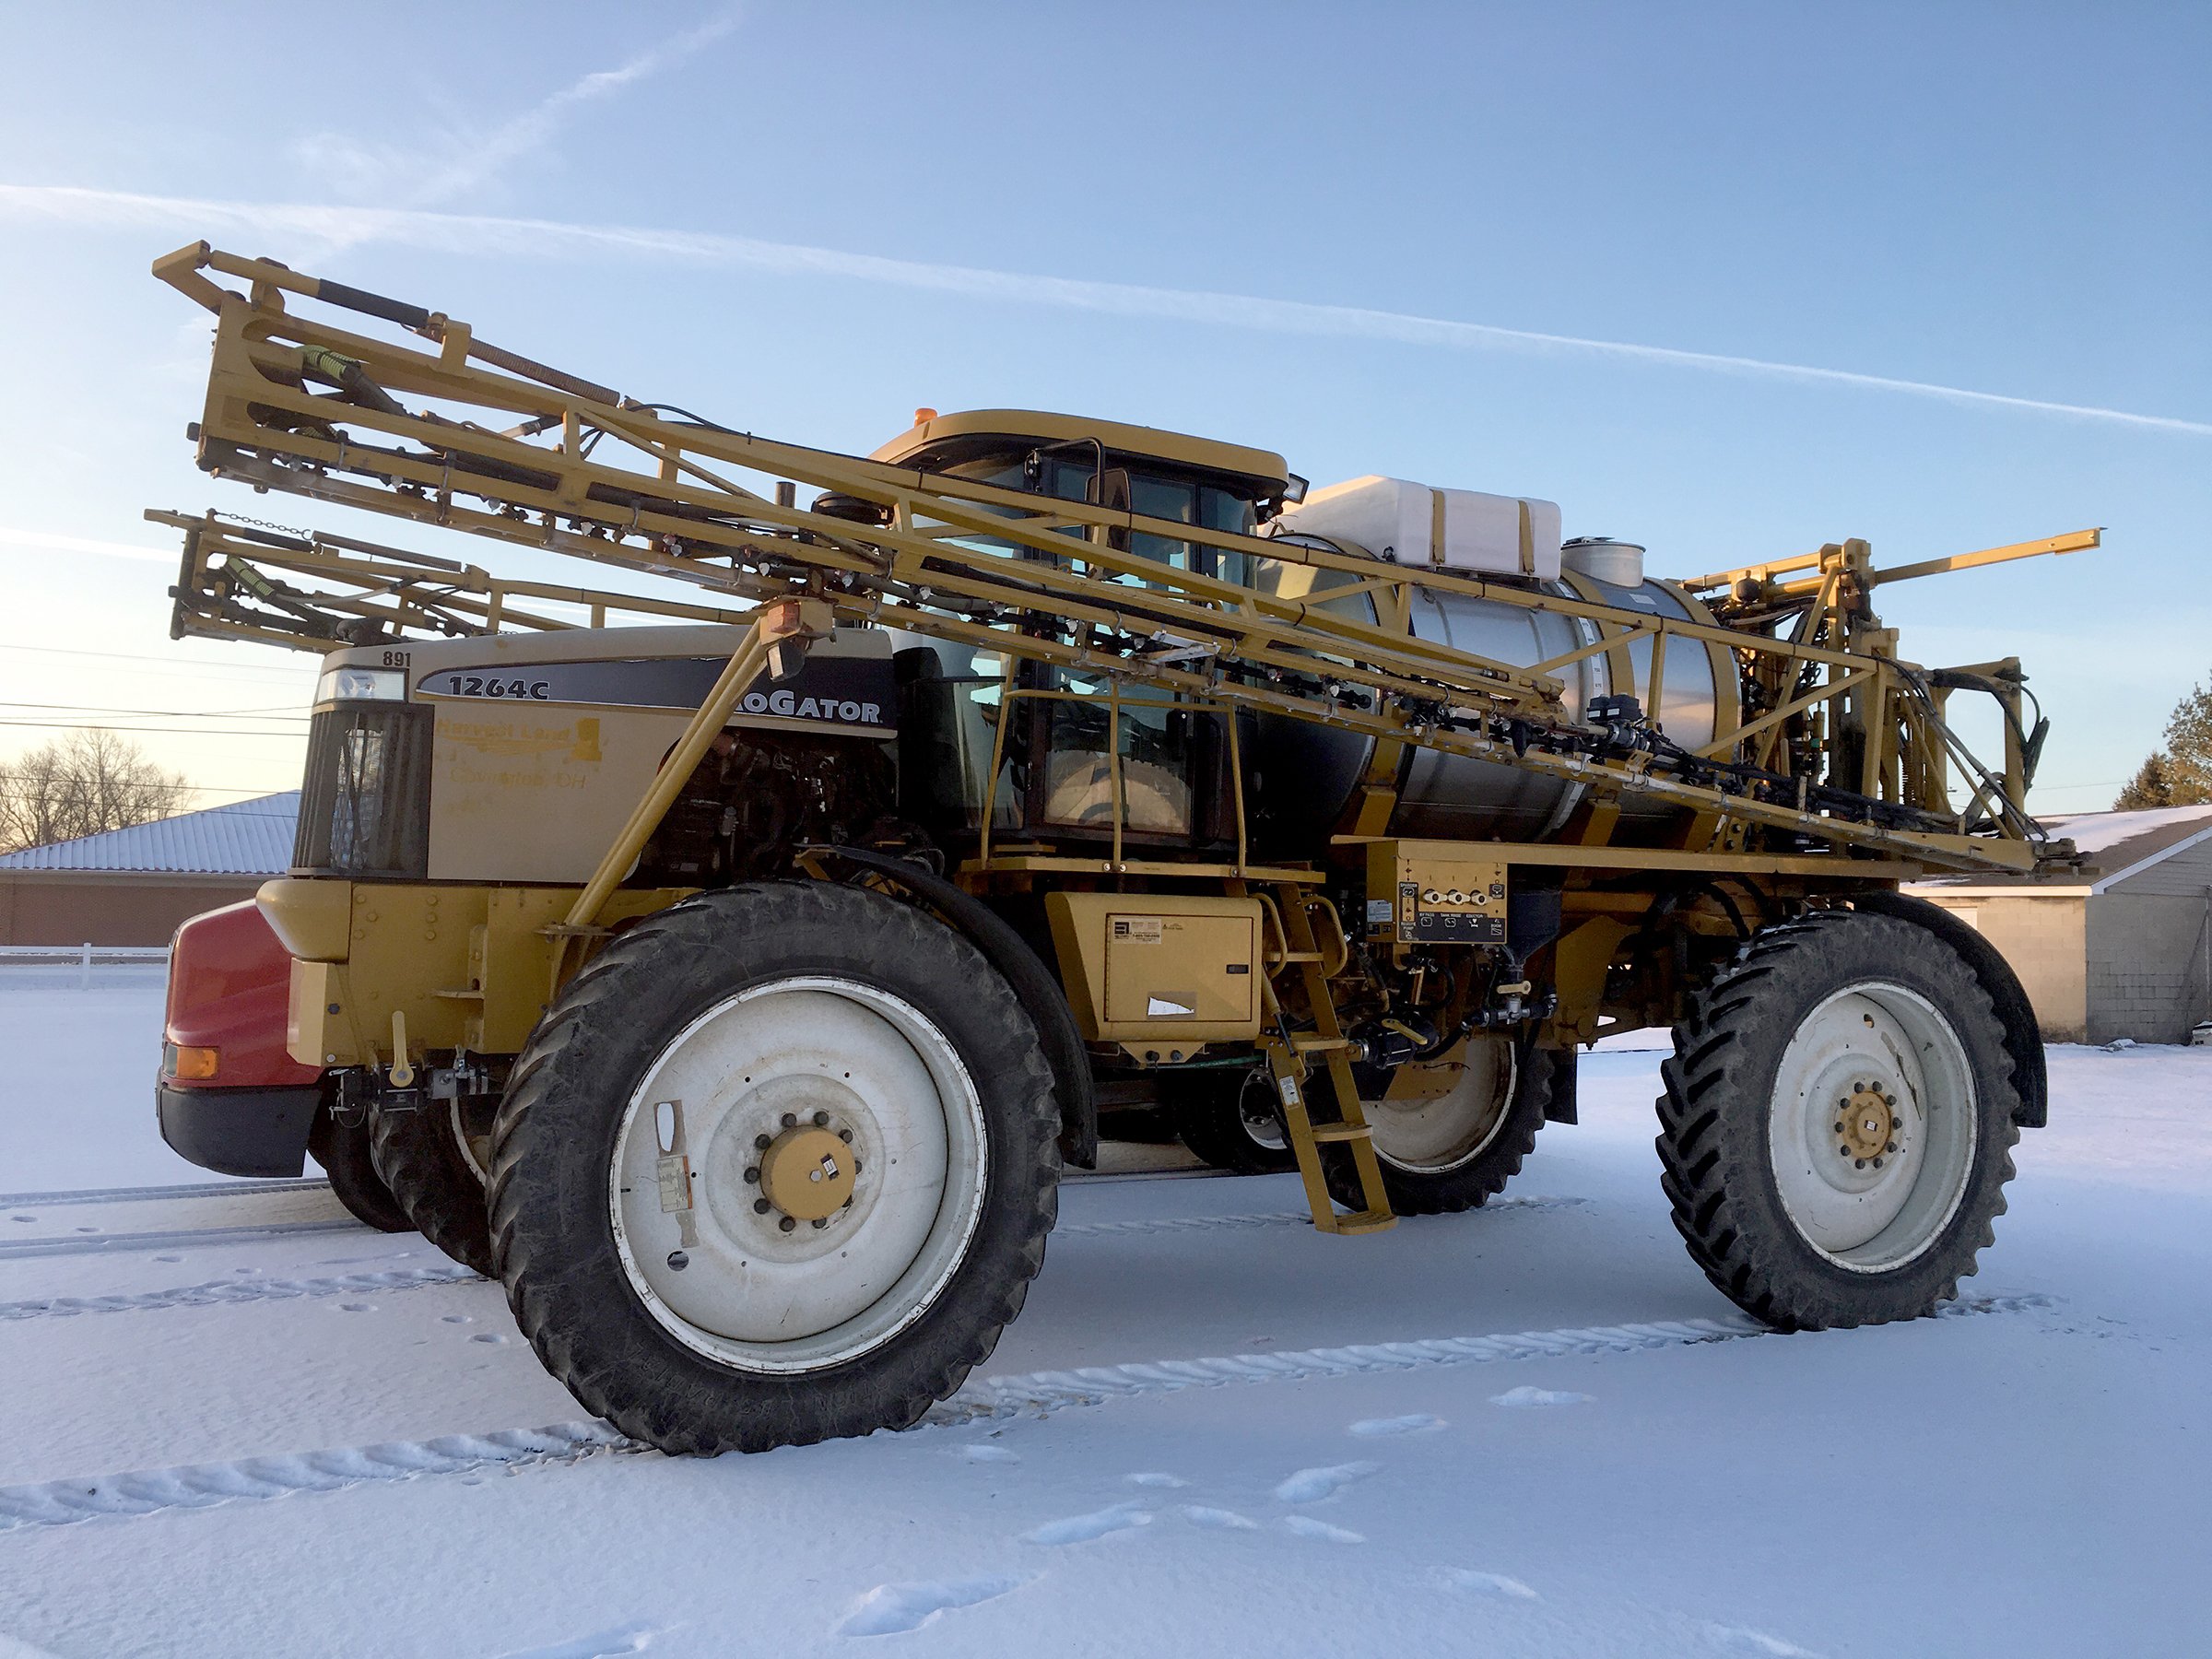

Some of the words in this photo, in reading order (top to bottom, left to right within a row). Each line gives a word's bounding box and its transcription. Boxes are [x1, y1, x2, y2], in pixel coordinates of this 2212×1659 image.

[382, 651, 411, 667] 891
[449, 676, 550, 700] 1264C
[735, 689, 880, 724] OGATOR
